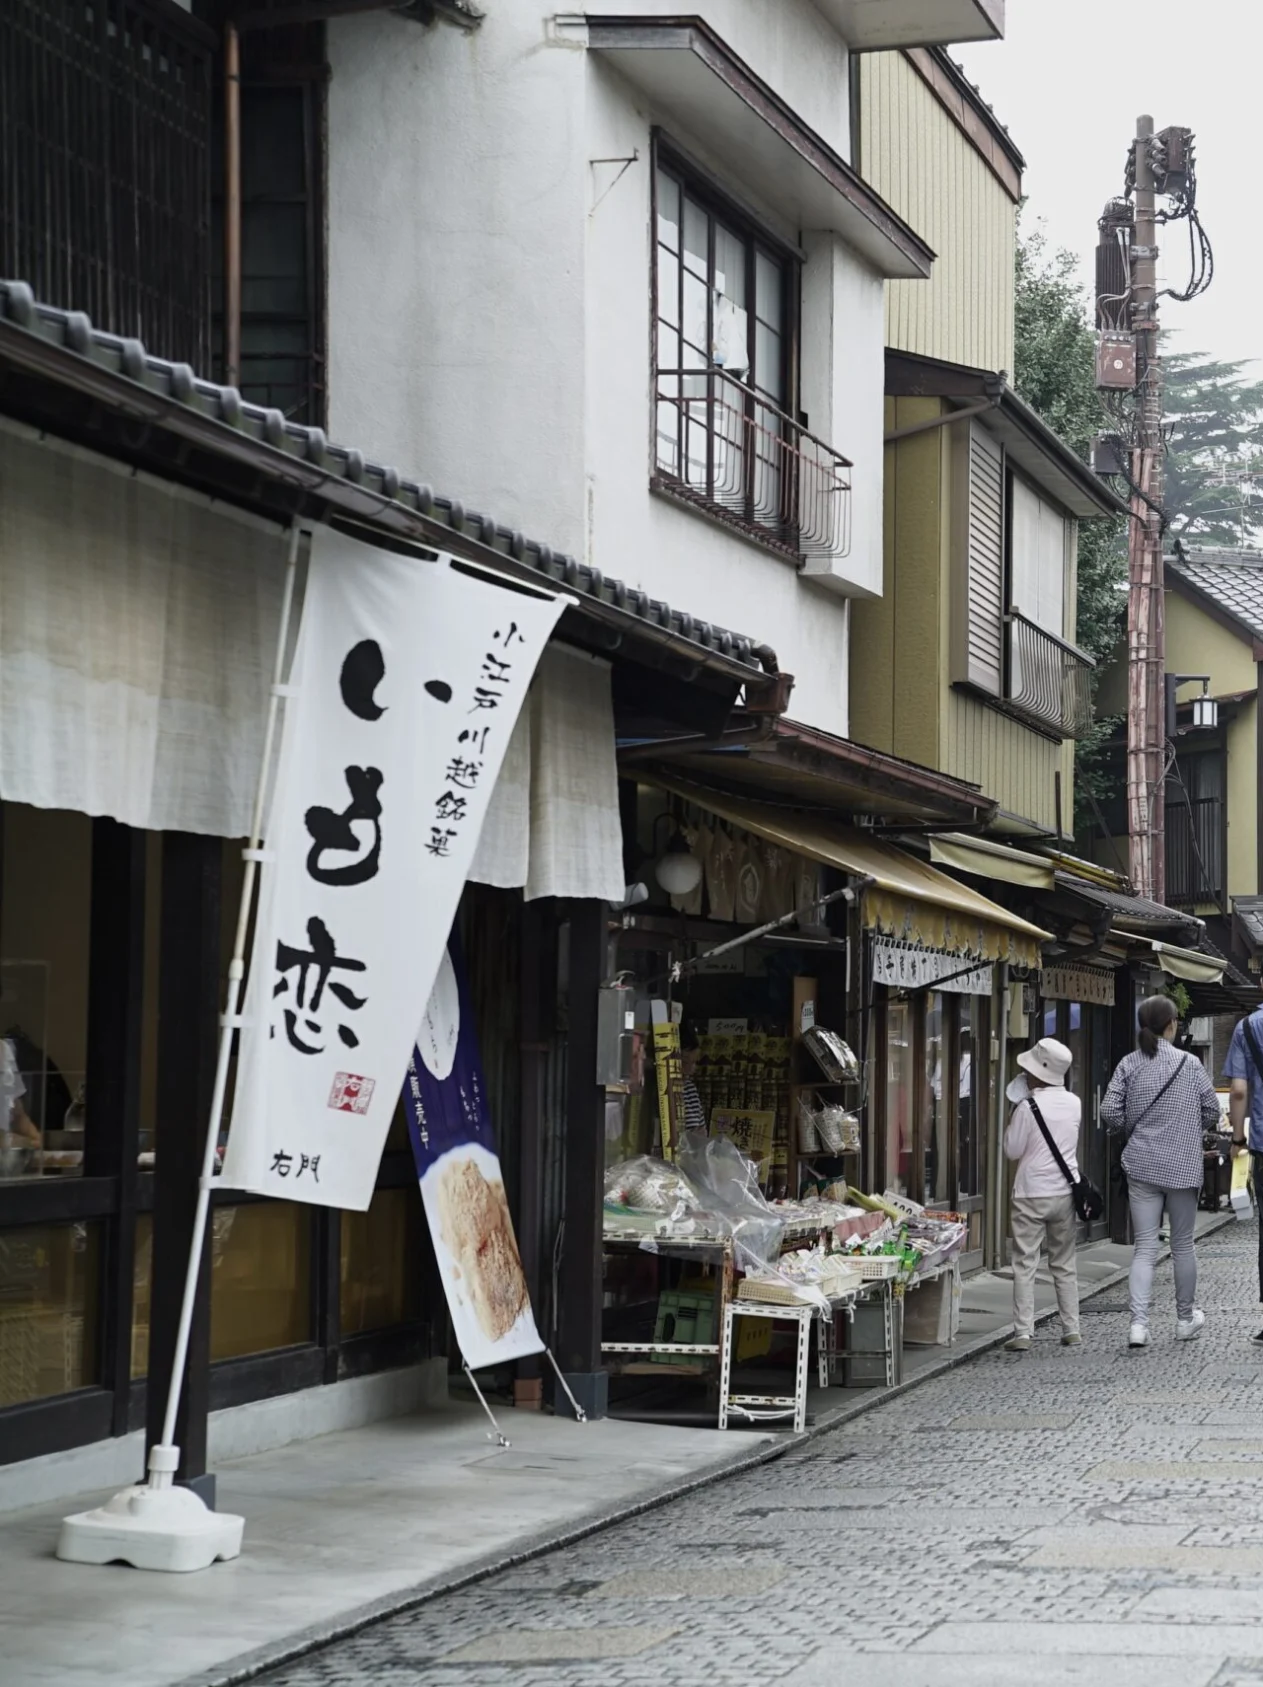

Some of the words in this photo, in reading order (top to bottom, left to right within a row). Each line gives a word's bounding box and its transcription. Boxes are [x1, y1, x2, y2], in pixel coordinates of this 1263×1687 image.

[270, 638, 453, 1056] いも恋
[424, 621, 525, 858] 小江戸川越銘菓
[269, 1148, 321, 1183] 右門
